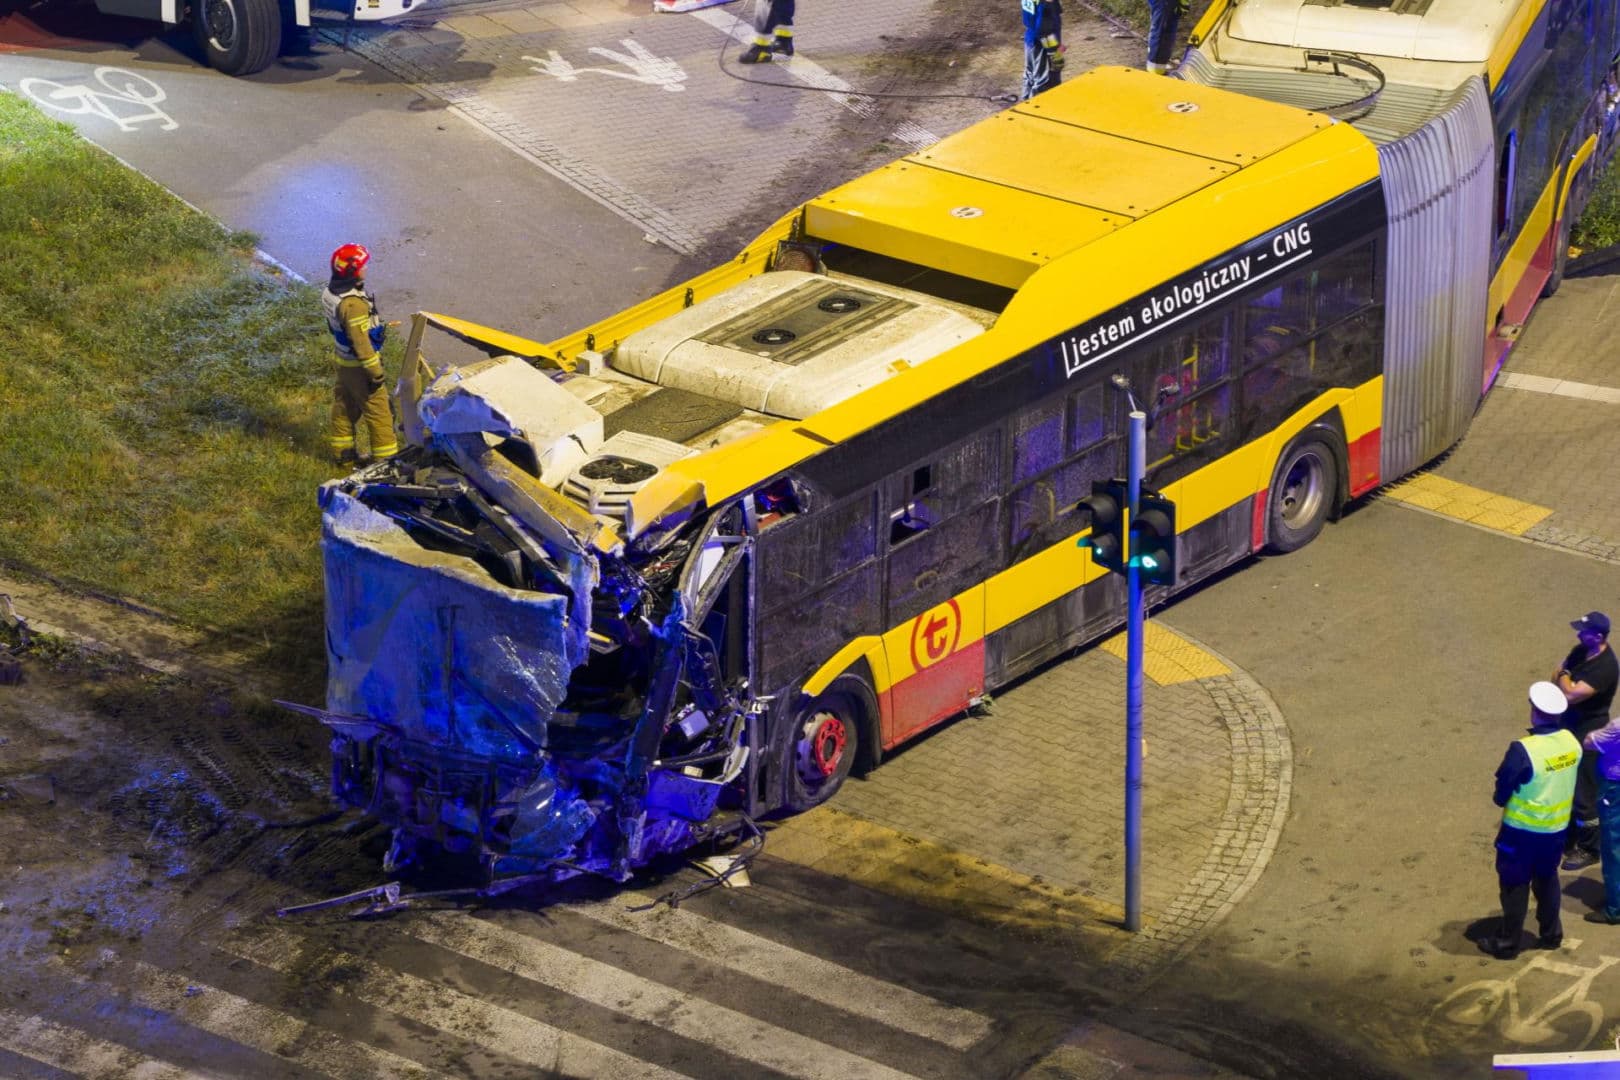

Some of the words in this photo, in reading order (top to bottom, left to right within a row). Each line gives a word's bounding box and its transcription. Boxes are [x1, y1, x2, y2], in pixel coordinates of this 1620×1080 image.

[1071, 315, 1136, 365] jestem
[1142, 256, 1250, 324] ekologiczny
[1272, 222, 1312, 257] CNG
